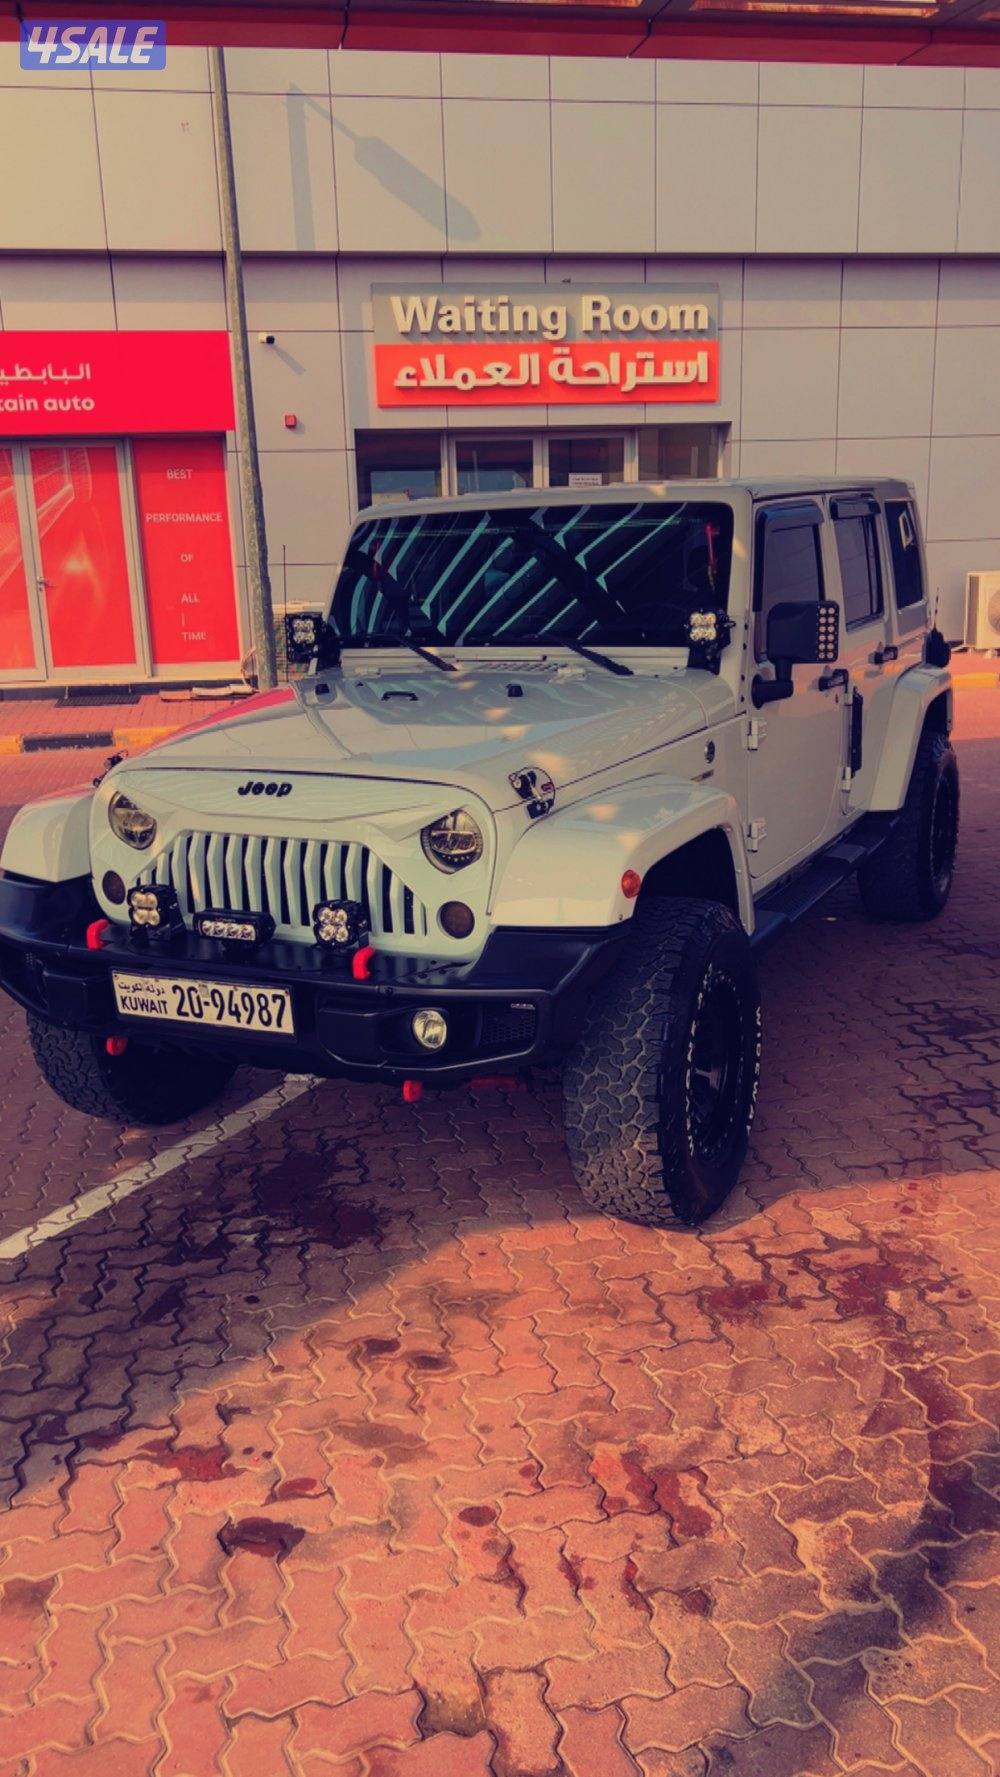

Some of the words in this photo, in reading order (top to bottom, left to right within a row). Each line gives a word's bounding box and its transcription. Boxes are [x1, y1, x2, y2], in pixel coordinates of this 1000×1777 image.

[390, 295, 567, 340] Waiting
[581, 295, 709, 332] Room
[394, 352, 541, 391] العملاء
[549, 347, 708, 392] استراحة
[43, 395, 95, 412] auto
[166, 468, 193, 480] BEST
[145, 512, 223, 523] PERFORMANCE
[180, 553, 193, 563] OF
[181, 593, 200, 604] ALL
[181, 632, 207, 641] TIME
[237, 781, 293, 797] Jeep
[120, 996, 168, 1014] KUWAIT
[171, 985, 286, 1028] 20-94987
